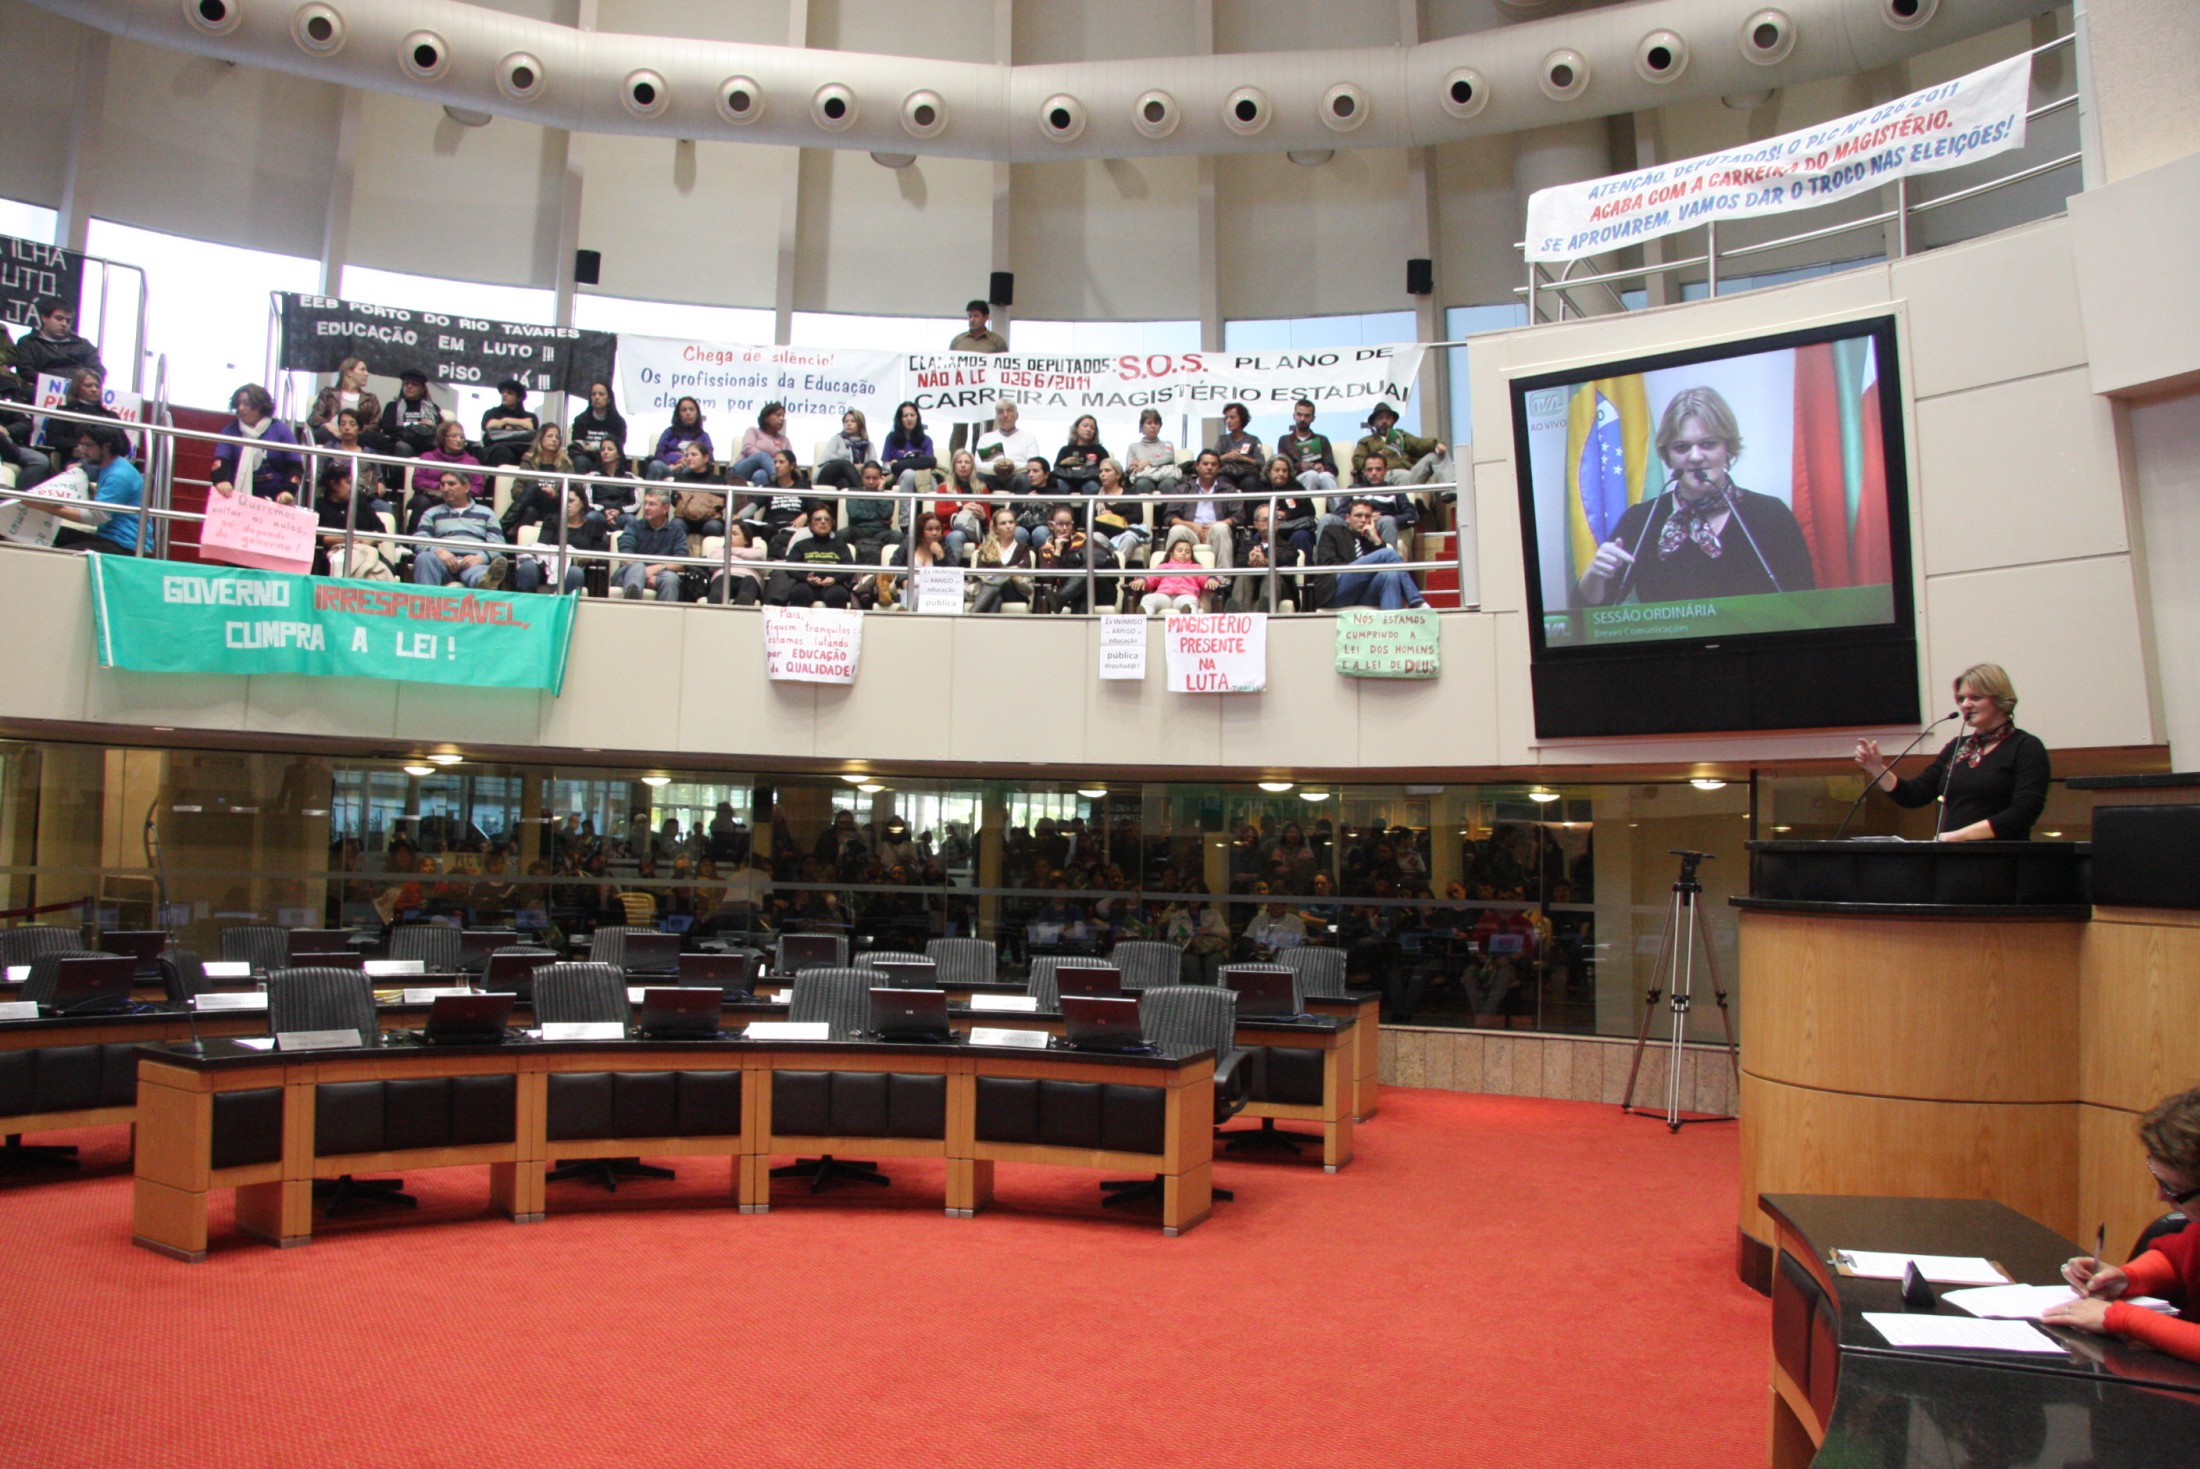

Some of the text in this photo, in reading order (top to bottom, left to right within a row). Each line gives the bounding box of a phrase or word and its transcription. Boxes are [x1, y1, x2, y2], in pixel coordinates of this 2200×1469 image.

[1588, 171, 1666, 200] ATENÇÃO,
[1673, 143, 1783, 178] DEPUTADOS!
[1788, 139, 1800, 155] O
[1805, 128, 1840, 151] PLC
[1870, 81, 1960, 124] 026/2011
[1589, 109, 1953, 222] ACABA COM A CARREIRA DO MAGISTÉRIO.
[1541, 114, 2015, 252] SE APROVAREM, VAMOS DAR O TROCO NAS ELEIÇÕES!
[11, 238, 67, 271] ILHA
[300, 295, 580, 339] EEB PORTO DO RIO TAVARES
[317, 321, 418, 346] EDUCAÇÃO
[438, 335, 464, 351] EM
[483, 340, 532, 358] LUTO
[683, 345, 733, 366] Chega
[743, 348, 761, 362] de
[994, 357, 1020, 370] AOS
[1118, 347, 1394, 381] S.O.S. PLANO DE
[640, 367, 876, 397] Os profissionais da Educação
[918, 370, 949, 388] NÃO
[654, 392, 716, 409] clam
[727, 398, 753, 413] por
[915, 388, 1067, 410] CARREIRA
[1081, 381, 1261, 408] MAGISTÉRIO
[1531, 419, 1567, 432] AO VIVO
[238, 494, 296, 520] Queremos
[163, 576, 531, 630] GOVERNO IRRESPONSÁVEL,
[1168, 613, 1251, 634] MAGISTÉRIO
[1383, 615, 1426, 624] ESTAMOS
[1593, 603, 1716, 625] SESSÃO ORDINÁRIA
[226, 620, 325, 651] CUMPRA
[351, 626, 368, 653] A
[766, 619, 796, 638] fiquem
[1346, 631, 1416, 639] CUMPRINDO A
[768, 635, 848, 647] estamos lutando
[1180, 637, 1246, 654] PRESENTE
[1344, 644, 1434, 654] LEI DOS HOMENS
[767, 648, 847, 662] por EDUCAÇÃO
[1107, 650, 1139, 660] pública
[1199, 658, 1216, 671] NA
[1353, 661, 1360, 669] A
[1365, 660, 1381, 669] LEI
[1390, 661, 1401, 669] DE
[770, 661, 856, 678] de QUALIDADE!
[1186, 672, 1229, 691] LUTA
